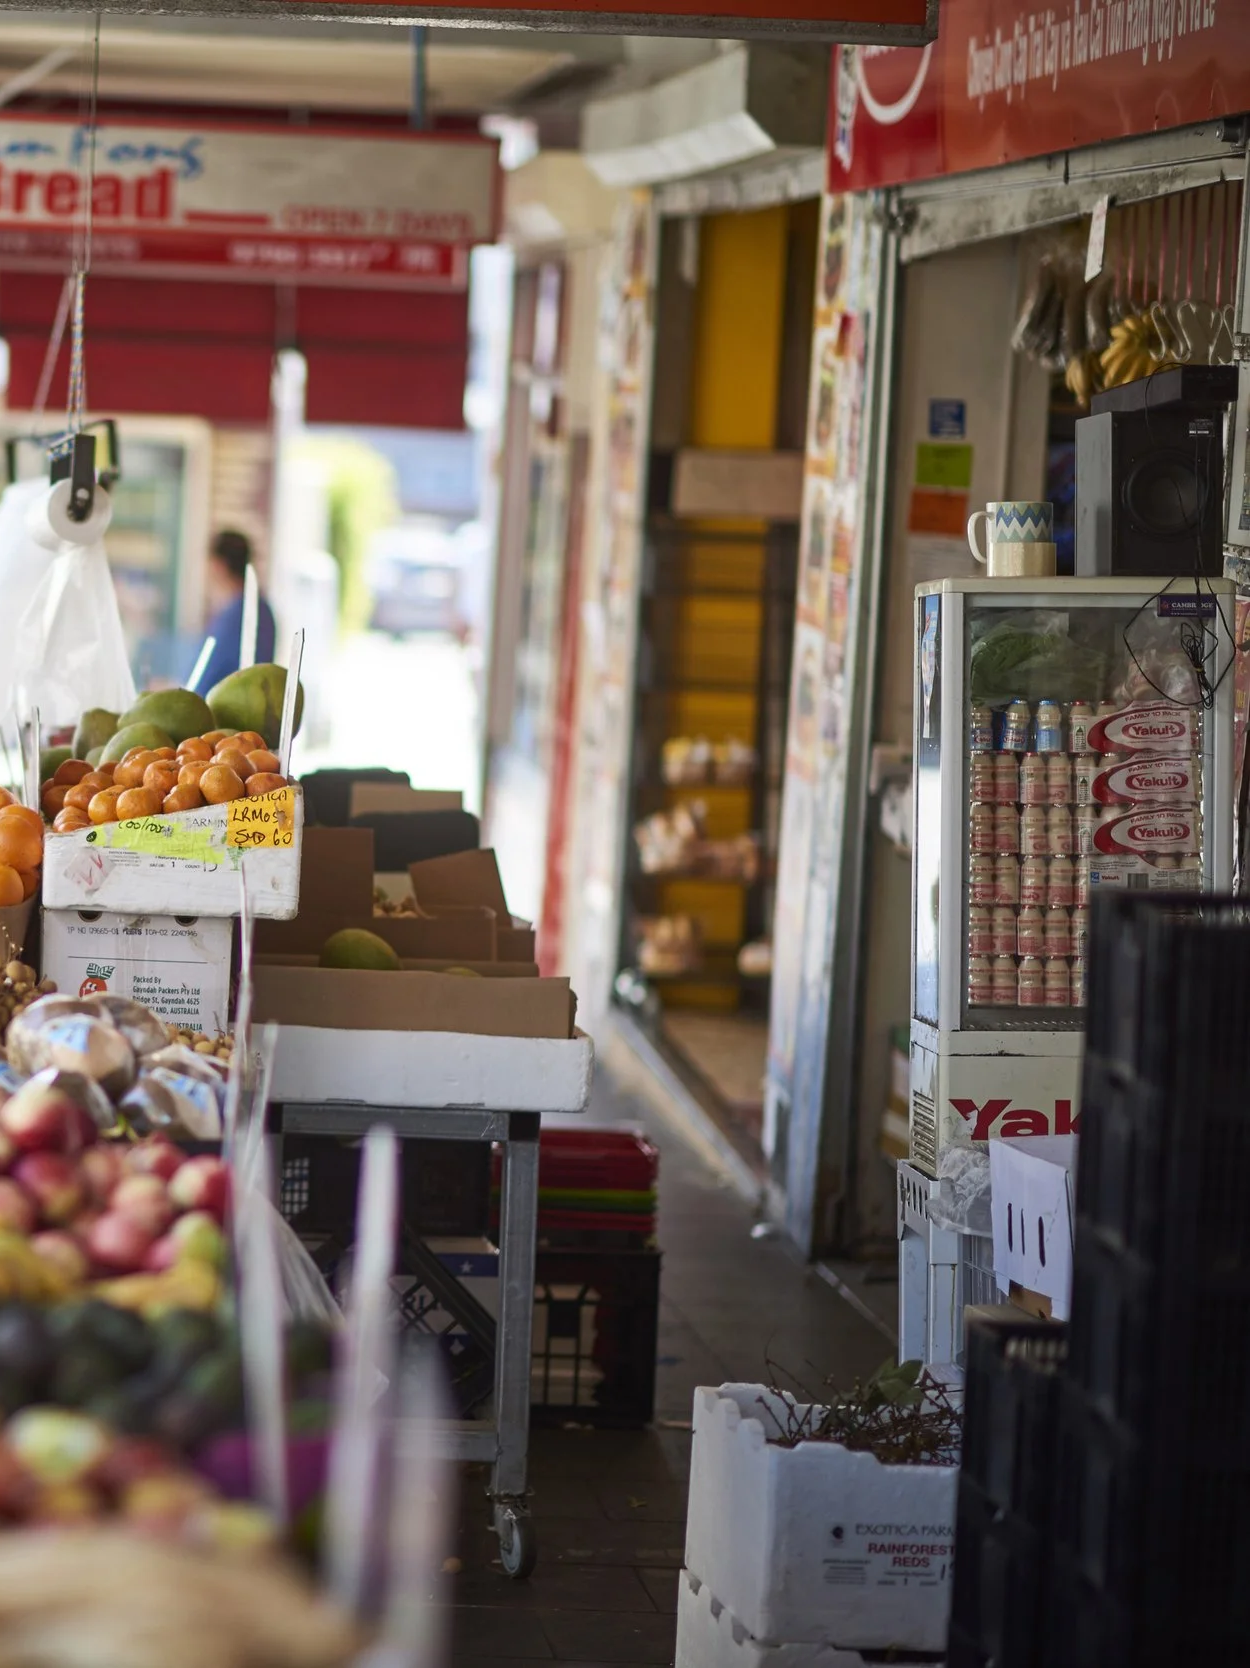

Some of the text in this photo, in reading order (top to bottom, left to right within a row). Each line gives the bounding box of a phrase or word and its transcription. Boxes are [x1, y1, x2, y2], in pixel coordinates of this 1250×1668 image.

[1132, 725, 1177, 736] Yakult
[1135, 776, 1180, 787] Yakult
[273, 828, 293, 845] 60
[1137, 827, 1182, 838] Yakult
[133, 975, 162, 985] Packed By
[132, 986, 157, 995] Gayndah
[158, 987, 180, 995] Packers
[191, 988, 201, 996] Ltd
[161, 997, 185, 1006] Gayndah
[186, 998, 200, 1006] 4625
[170, 1007, 200, 1015] AUSTRALIA
[855, 1523, 919, 1536] EXOTICA
[868, 1542, 956, 1556] RAINFOREST
[892, 1556, 931, 1568] REDS
